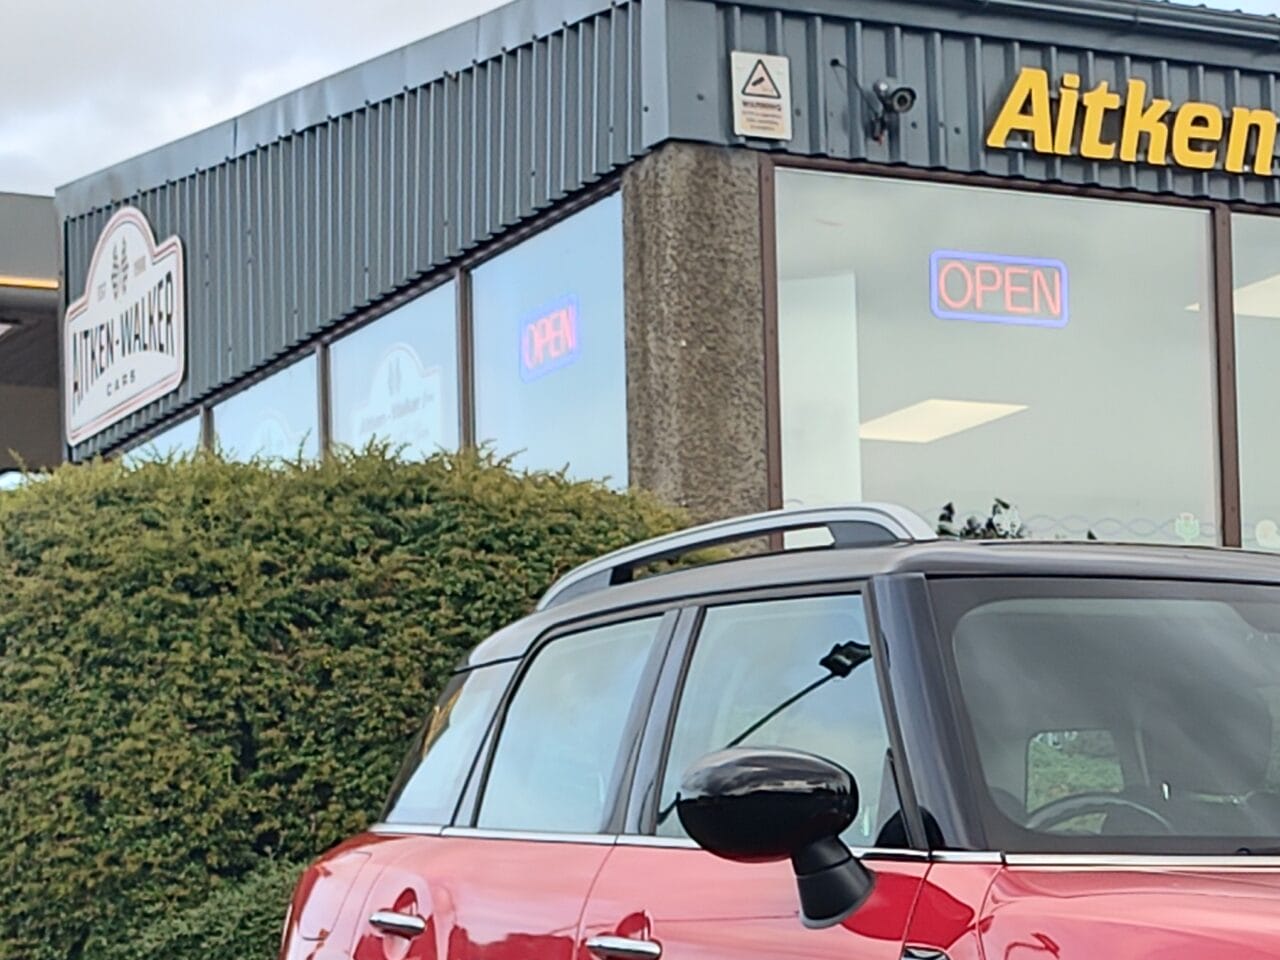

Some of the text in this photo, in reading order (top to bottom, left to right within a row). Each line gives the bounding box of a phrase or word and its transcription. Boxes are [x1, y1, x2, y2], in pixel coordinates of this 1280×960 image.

[986, 66, 1279, 176] Aitken
[938, 260, 1062, 316] OPEN
[72, 270, 175, 416] AITKEN-WALKER
[523, 304, 578, 370] OPEN
[106, 368, 137, 397] CARS
